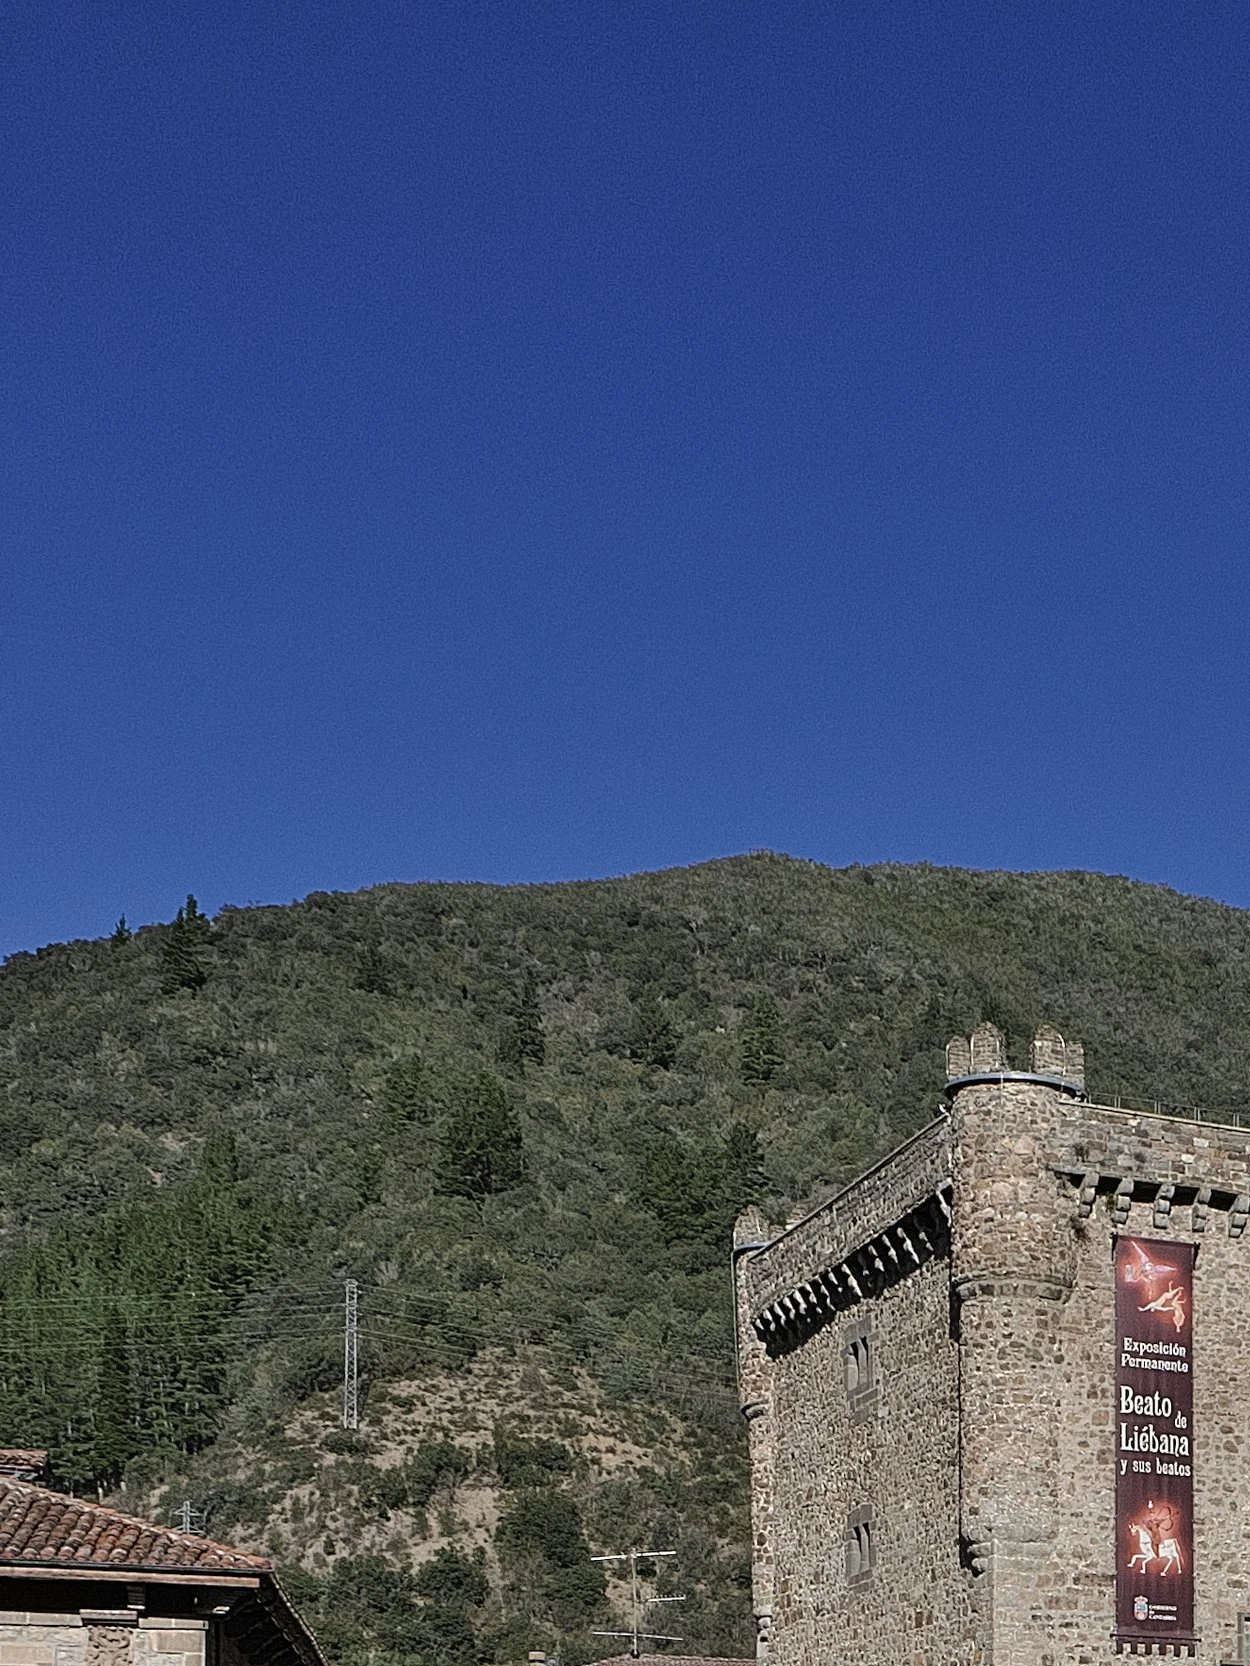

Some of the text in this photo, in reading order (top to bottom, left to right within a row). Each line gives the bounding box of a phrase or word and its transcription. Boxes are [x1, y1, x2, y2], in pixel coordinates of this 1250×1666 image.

[1123, 1337, 1187, 1357] Exposición
[1121, 1355, 1189, 1373] Permanente
[1120, 1385, 1188, 1429] Beato de
[1120, 1422, 1190, 1457] Liébana
[1120, 1457, 1191, 1477] y sus beatos
